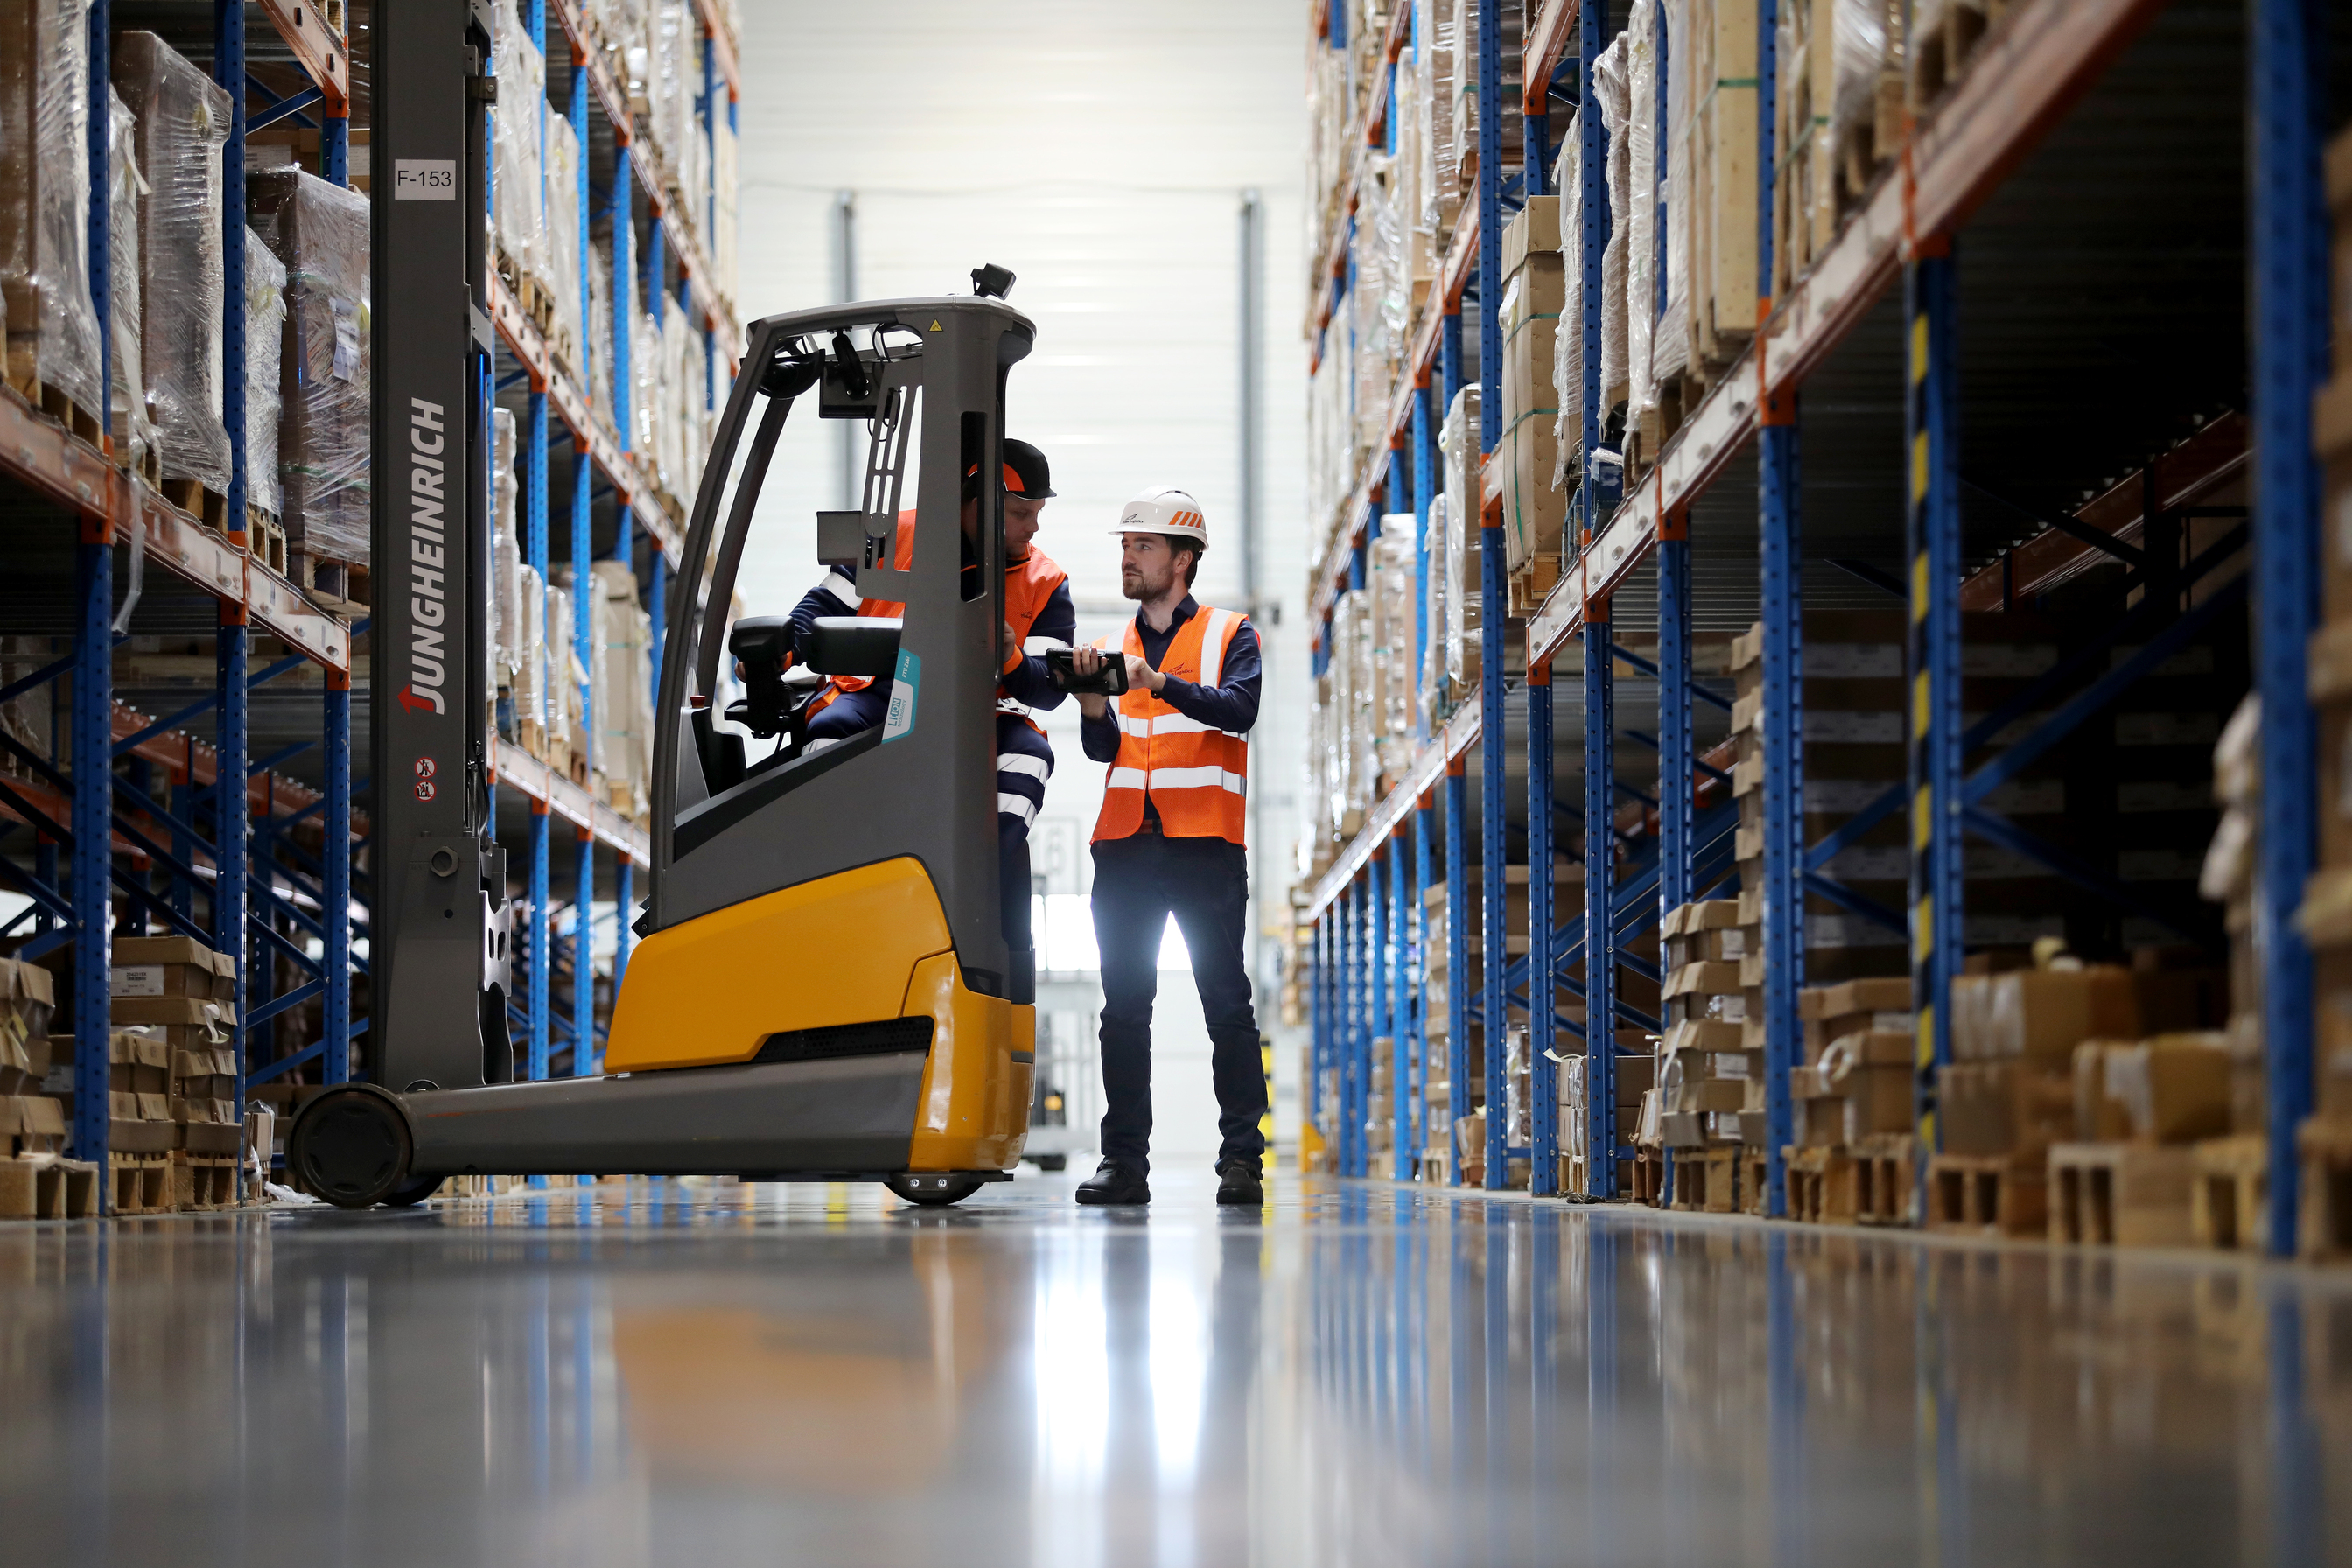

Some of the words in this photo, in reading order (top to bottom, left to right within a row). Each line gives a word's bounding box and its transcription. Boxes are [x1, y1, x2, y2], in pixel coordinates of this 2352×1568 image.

[397, 170, 452, 187] F-153
[410, 396, 445, 716] JUNGHEINRICH
[897, 699, 907, 728] technology
